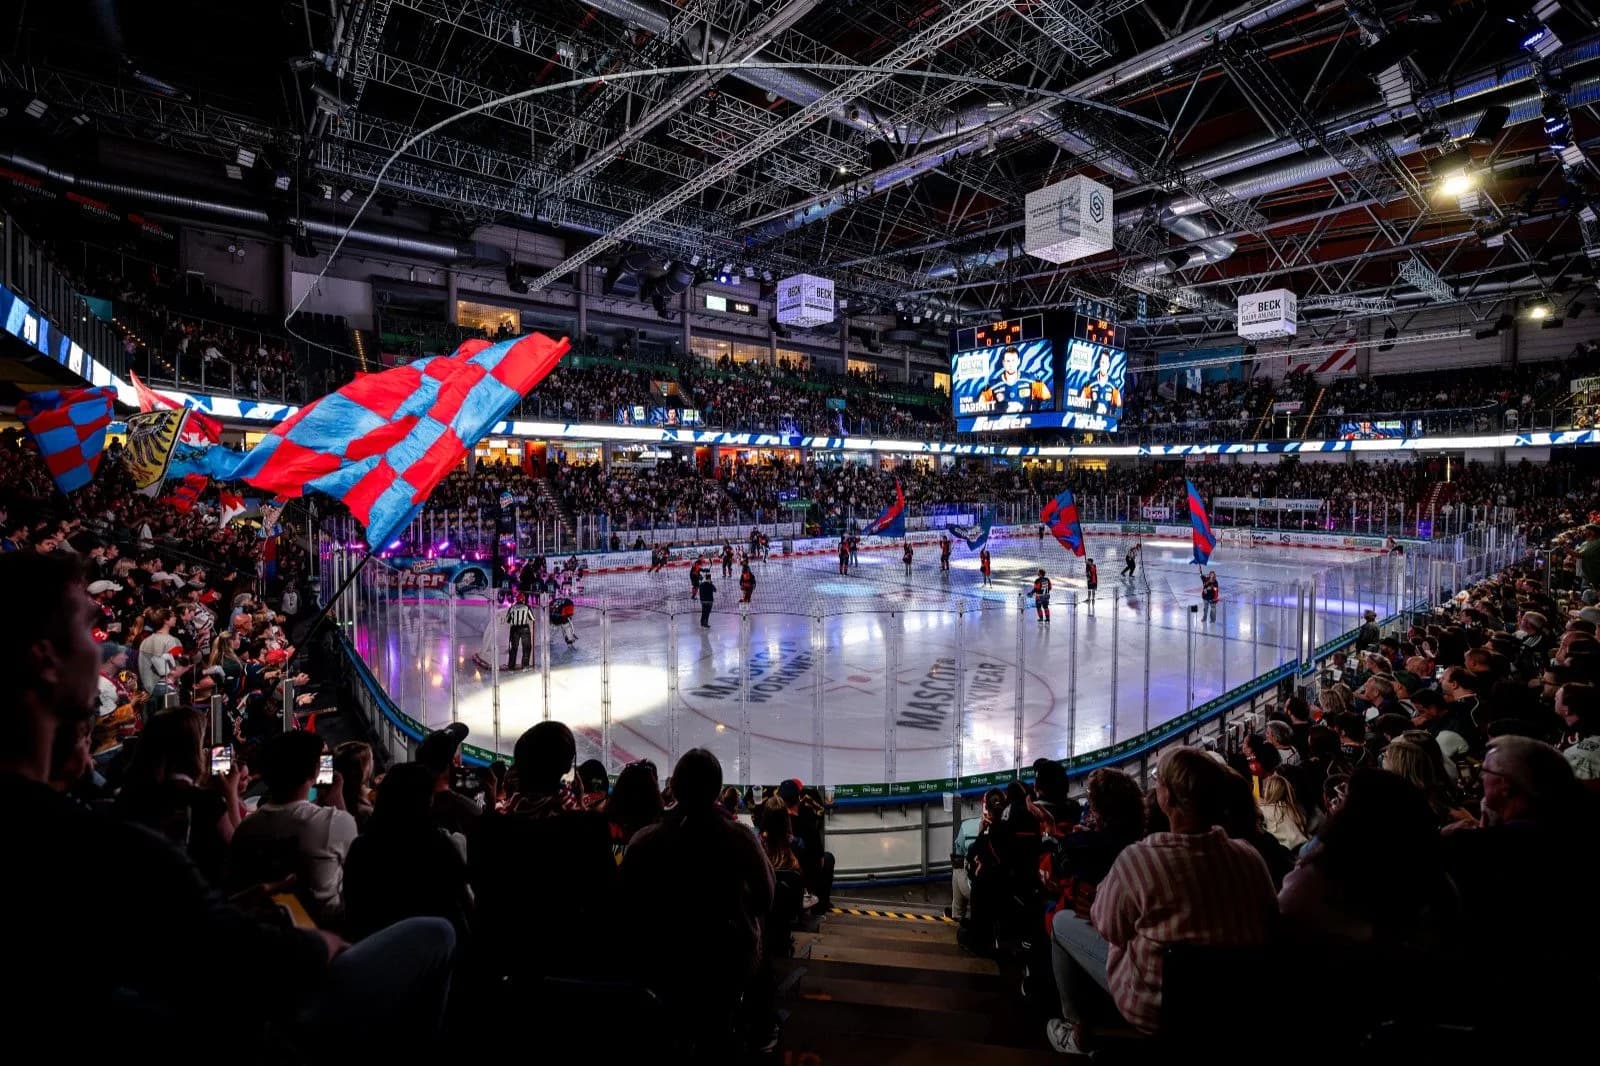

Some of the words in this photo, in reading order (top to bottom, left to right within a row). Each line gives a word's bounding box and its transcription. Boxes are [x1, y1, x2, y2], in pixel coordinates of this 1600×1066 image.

[83, 203, 121, 222] SPEDITION
[816, 287, 832, 300] BECK
[1258, 299, 1281, 312] BECK
